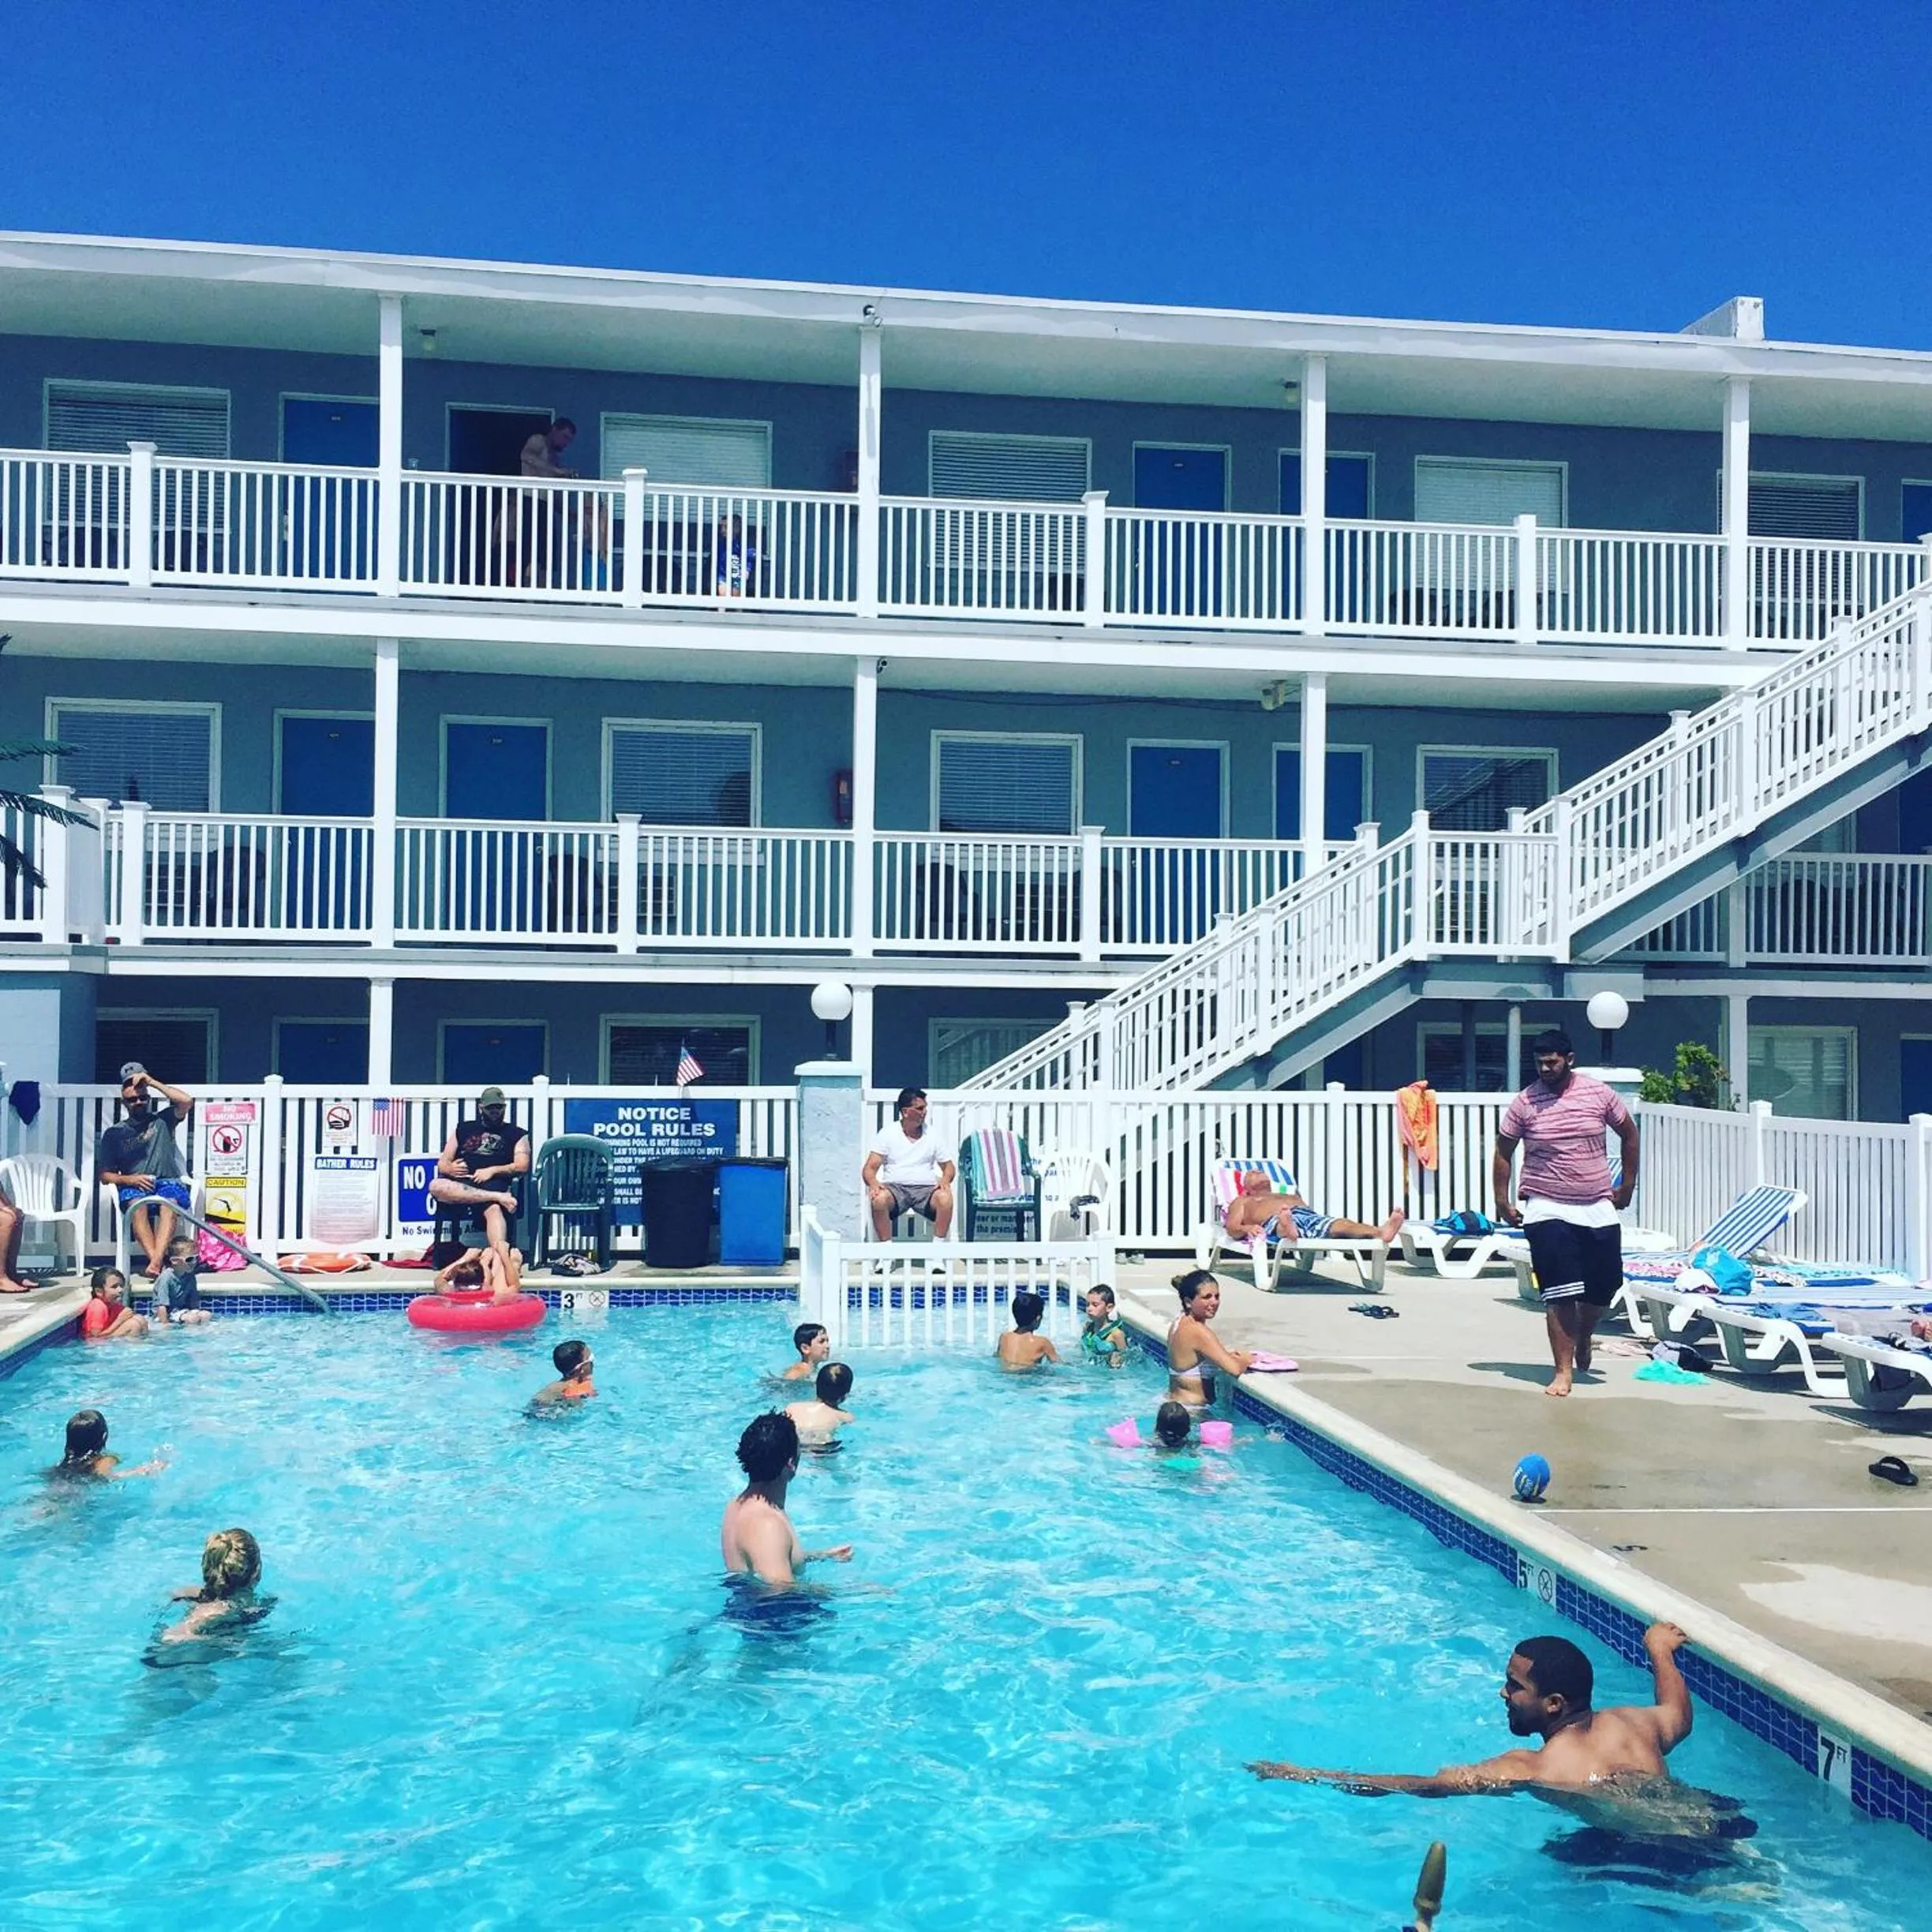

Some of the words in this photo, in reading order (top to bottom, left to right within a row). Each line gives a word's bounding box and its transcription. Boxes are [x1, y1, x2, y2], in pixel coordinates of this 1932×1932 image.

[209, 1112, 253, 1121] SMOKING
[617, 1106, 691, 1121] NOTICE
[593, 1123, 646, 1136] POOL
[651, 1123, 716, 1136] RULES
[706, 1147, 724, 1155] DUTY
[316, 1159, 347, 1169] BATHER
[350, 1159, 375, 1169] RULES
[403, 1165, 425, 1189] NO
[402, 1226, 414, 1235] No
[564, 1293, 575, 1309] 3
[1518, 1559, 1527, 1589] 5
[1821, 1735, 1836, 1782] 7
[1837, 1745, 1848, 1765] FT
